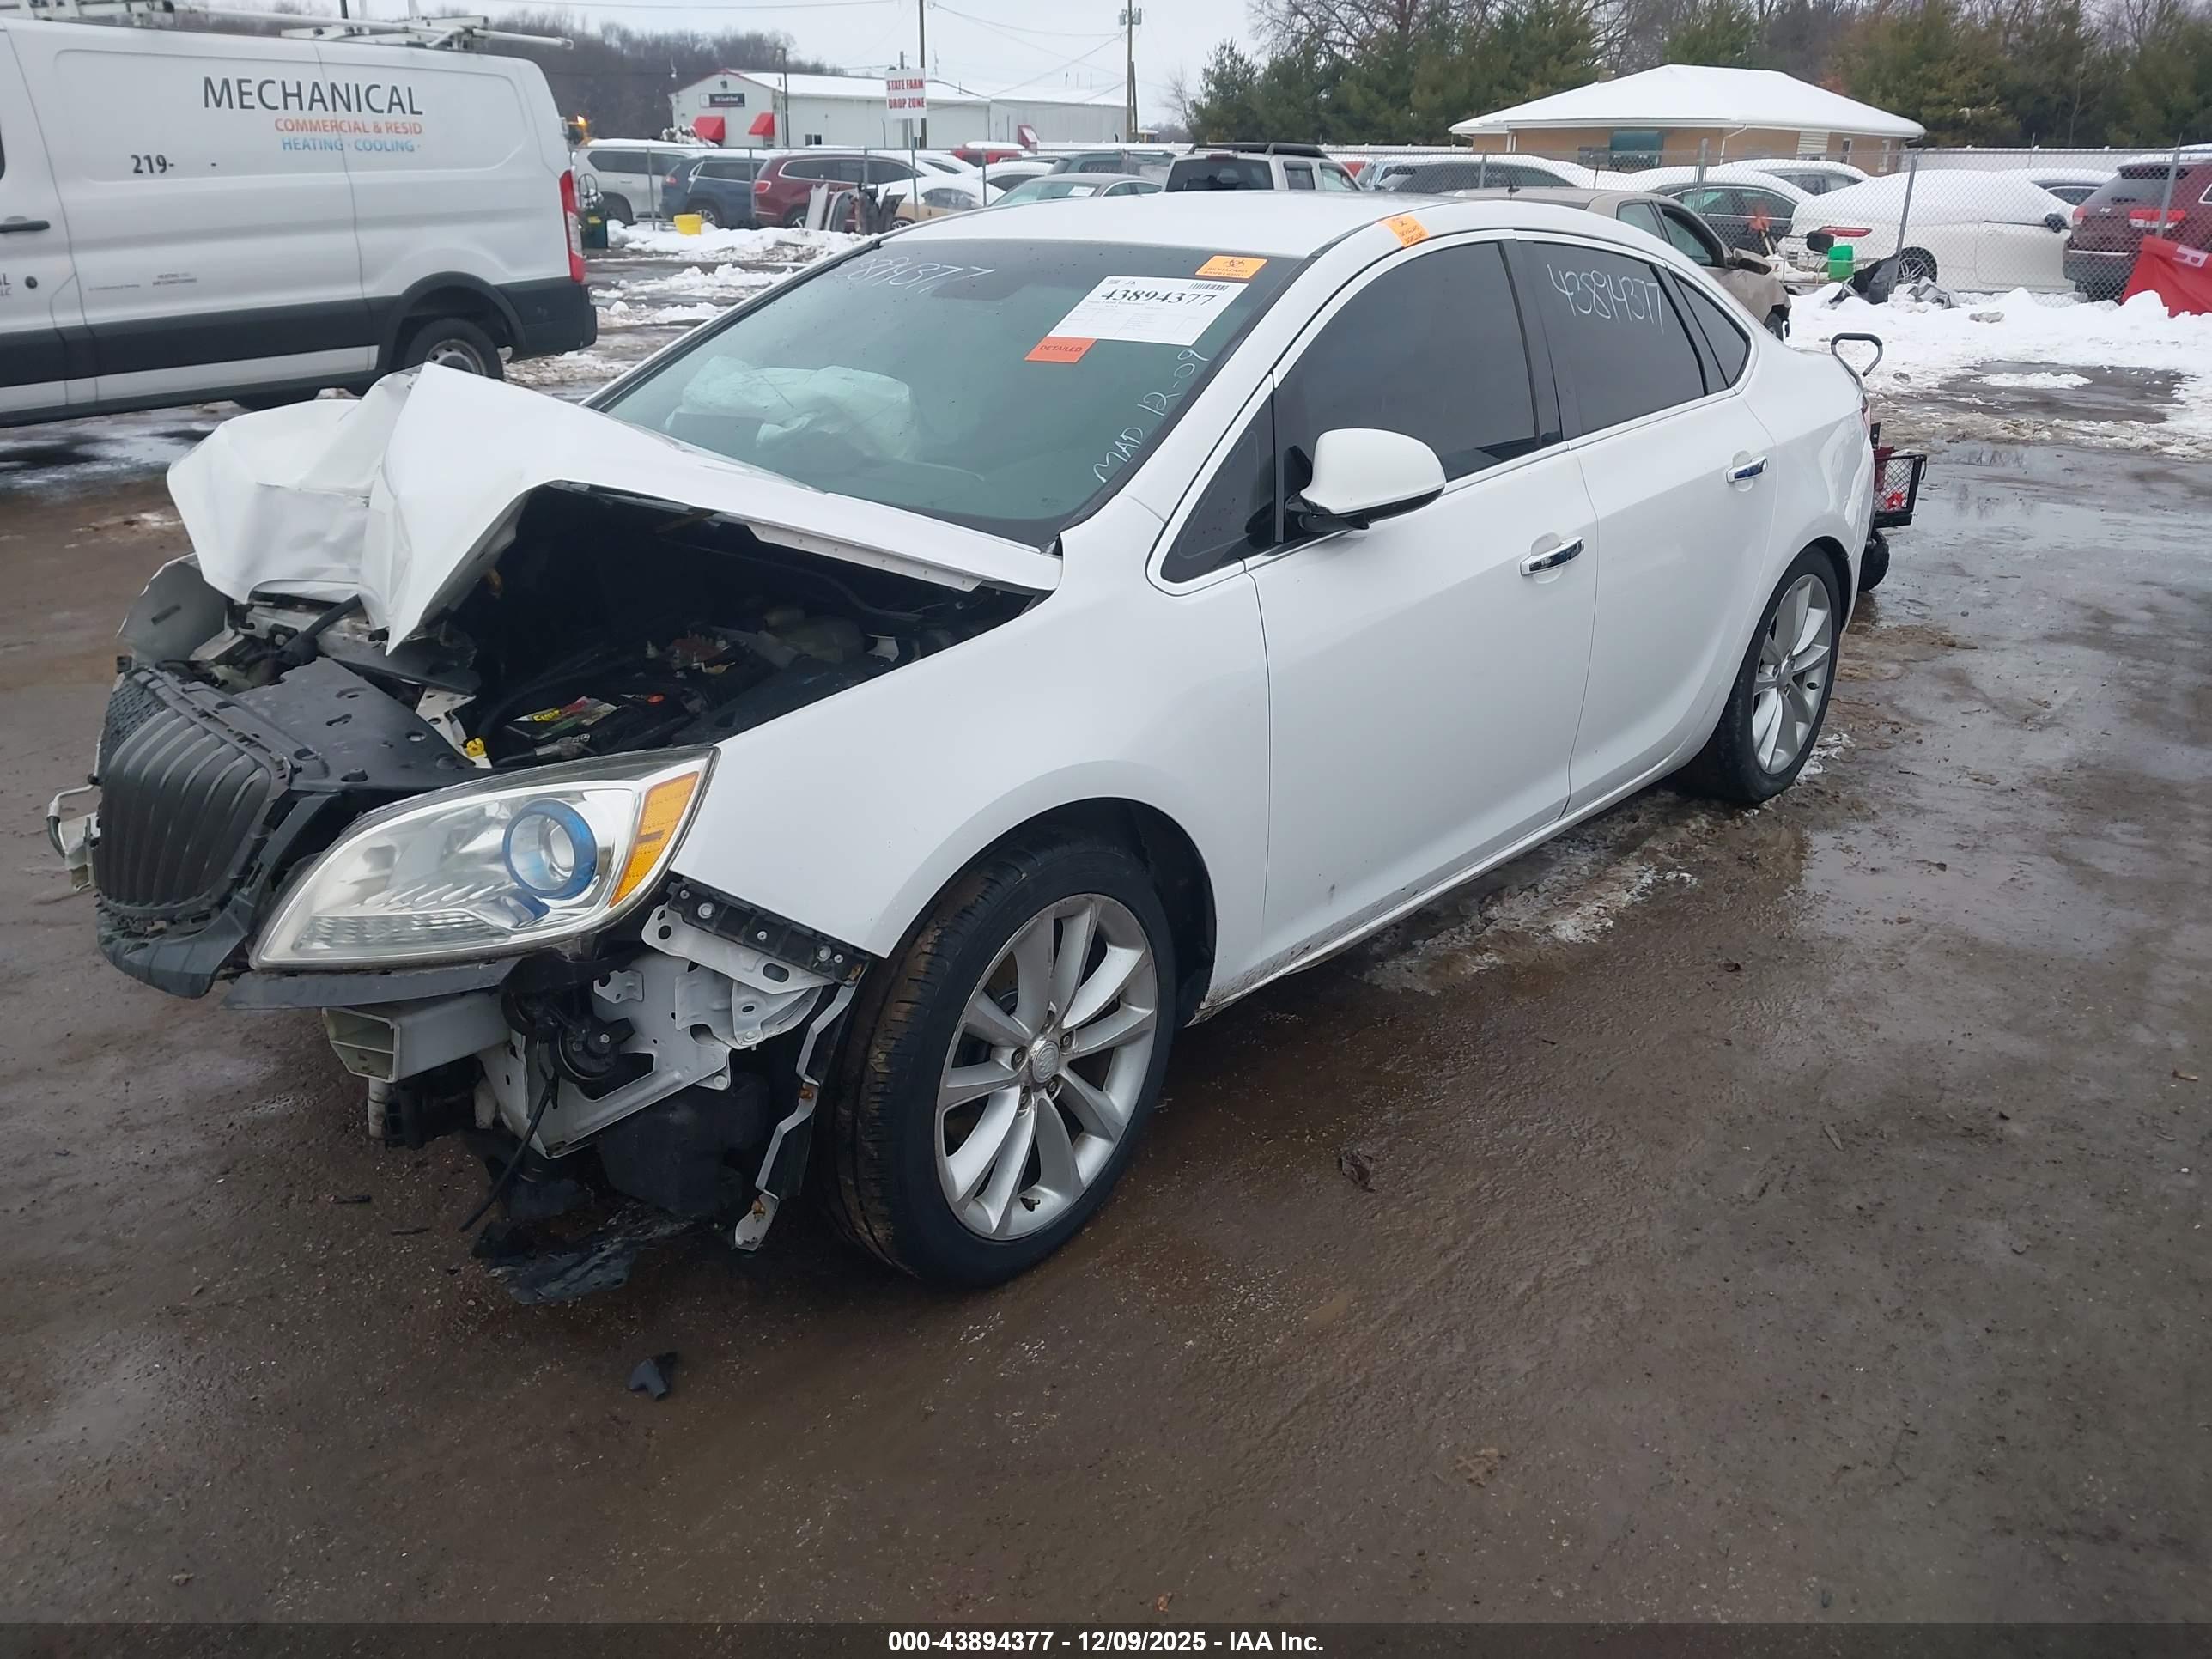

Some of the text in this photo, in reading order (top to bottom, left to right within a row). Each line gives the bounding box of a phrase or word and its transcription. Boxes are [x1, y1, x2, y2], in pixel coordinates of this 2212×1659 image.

[887, 78, 924, 91] STATE FARM
[203, 76, 423, 116] MECHANICAL
[888, 96, 926, 110] DROP ZONE
[275, 118, 423, 135] COMMERCIAL & RESID
[282, 137, 416, 153] HEATING COOLING
[130, 154, 175, 174] 219-
[1100, 289, 1218, 306] 43894377
[1547, 264, 1664, 335] 43894377
[1092, 349, 1210, 483] MAD 12-09
